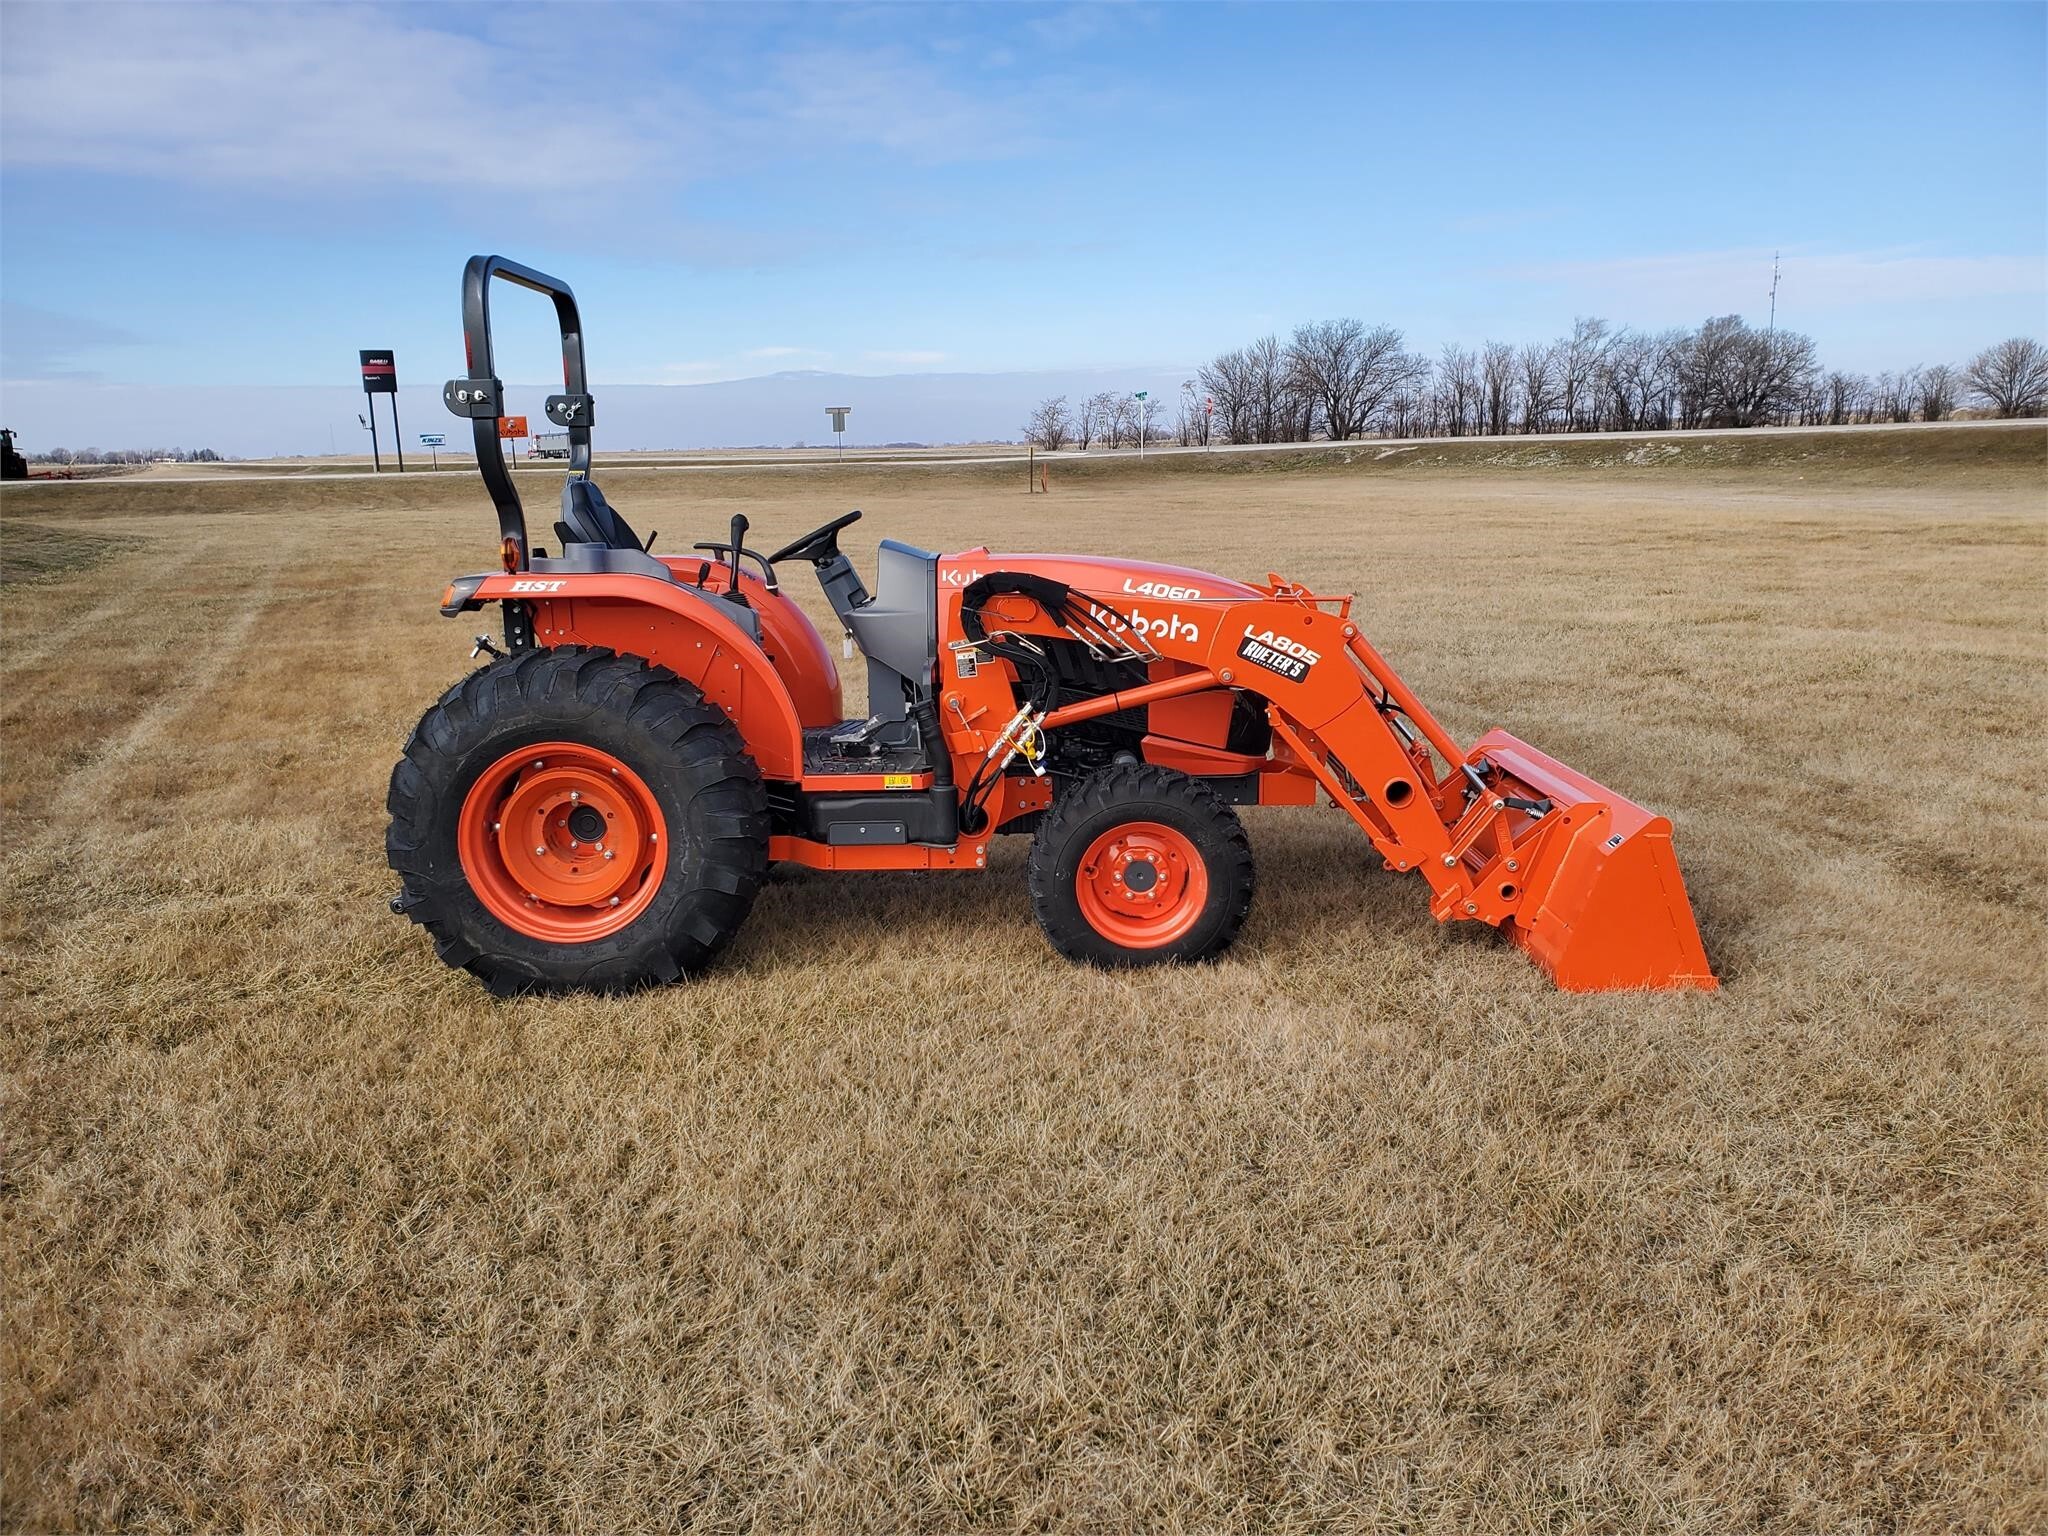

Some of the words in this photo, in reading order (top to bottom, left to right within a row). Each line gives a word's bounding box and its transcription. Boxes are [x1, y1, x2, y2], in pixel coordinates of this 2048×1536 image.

[511, 580, 568, 592] HST
[1123, 578, 1201, 600] L4060
[1089, 603, 1199, 642] Kubota
[1242, 640, 1305, 677] RUETER'S
[1243, 624, 1322, 666] LA805
